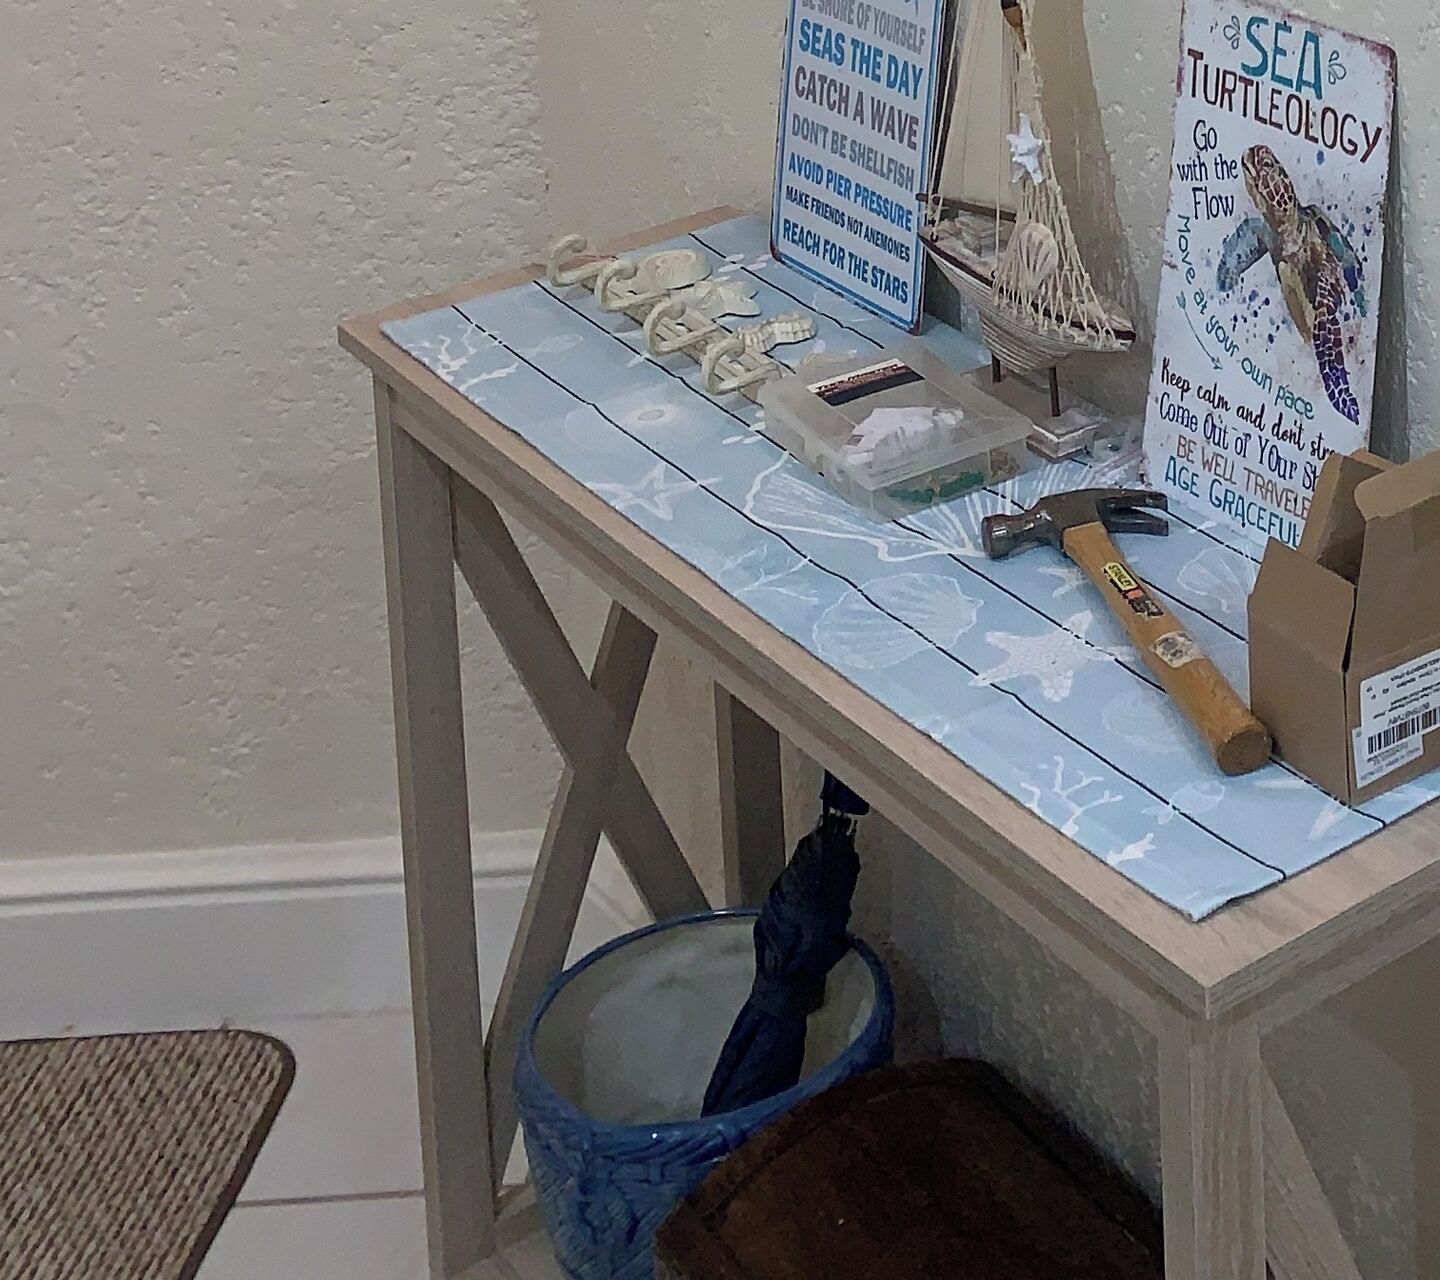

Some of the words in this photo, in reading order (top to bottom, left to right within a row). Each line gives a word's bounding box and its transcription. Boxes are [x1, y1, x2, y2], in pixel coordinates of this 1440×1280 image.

[799, 19, 846, 66] SEAS
[850, 37, 884, 84] THE
[886, 54, 924, 100] DAY
[857, 2, 872, 31] OF
[873, 7, 927, 55] YOURSELF
[1240, 15, 1324, 100] SEA
[794, 65, 851, 117] CATCH
[852, 91, 865, 125] A
[870, 96, 920, 151] WAVE
[1187, 48, 1383, 164] TURTLEOLOGY
[1193, 119, 1218, 153] Go
[788, 152, 824, 186] AVOID
[825, 169, 852, 201] PIER
[853, 182, 914, 233] PRESSURE
[791, 112, 829, 151] DON'T
[830, 128, 847, 159] BE
[849, 140, 915, 193] SHELLFISH
[1177, 155, 1209, 182] with
[1214, 153, 1239, 180] the
[785, 185, 810, 211] MAKE
[810, 197, 846, 229] FRIENDS
[847, 215, 864, 237] NOT
[863, 222, 911, 263] ANEMONES
[1191, 186, 1235, 221] Flow
[783, 217, 821, 259] REACH
[822, 238, 846, 271] FOR
[847, 252, 869, 283] THE
[870, 265, 909, 305] STARS
[1177, 213, 1196, 286] Move
[1193, 288, 1209, 316] at
[1205, 314, 1240, 358] your
[1240, 357, 1273, 391] own
[1274, 384, 1315, 421] pace
[1159, 392, 1198, 433] Come
[1203, 412, 1229, 450] Out
[1234, 431, 1252, 458] of
[1161, 357, 1192, 396] Keep
[1197, 382, 1231, 413] calm
[1236, 403, 1266, 432] and
[1271, 411, 1306, 452] don't
[1164, 455, 1200, 498] AGE
[1176, 434, 1197, 465] BE
[1202, 446, 1237, 486] WELL
